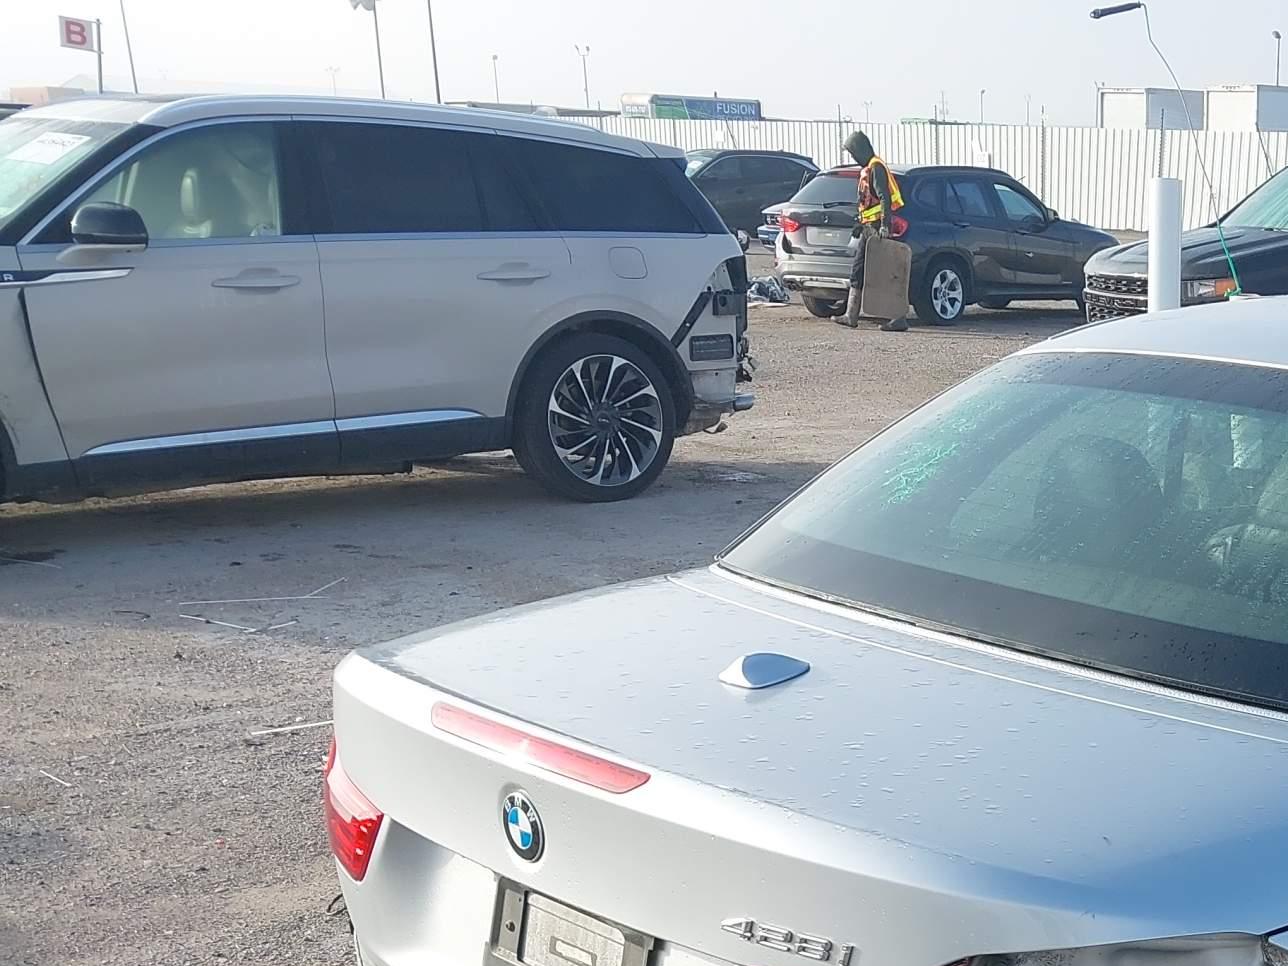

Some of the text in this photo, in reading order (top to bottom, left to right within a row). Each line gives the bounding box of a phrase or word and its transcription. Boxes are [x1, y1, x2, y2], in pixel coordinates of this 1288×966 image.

[65, 20, 87, 46] B
[716, 103, 756, 116] FUSION
[504, 793, 537, 823] BMW
